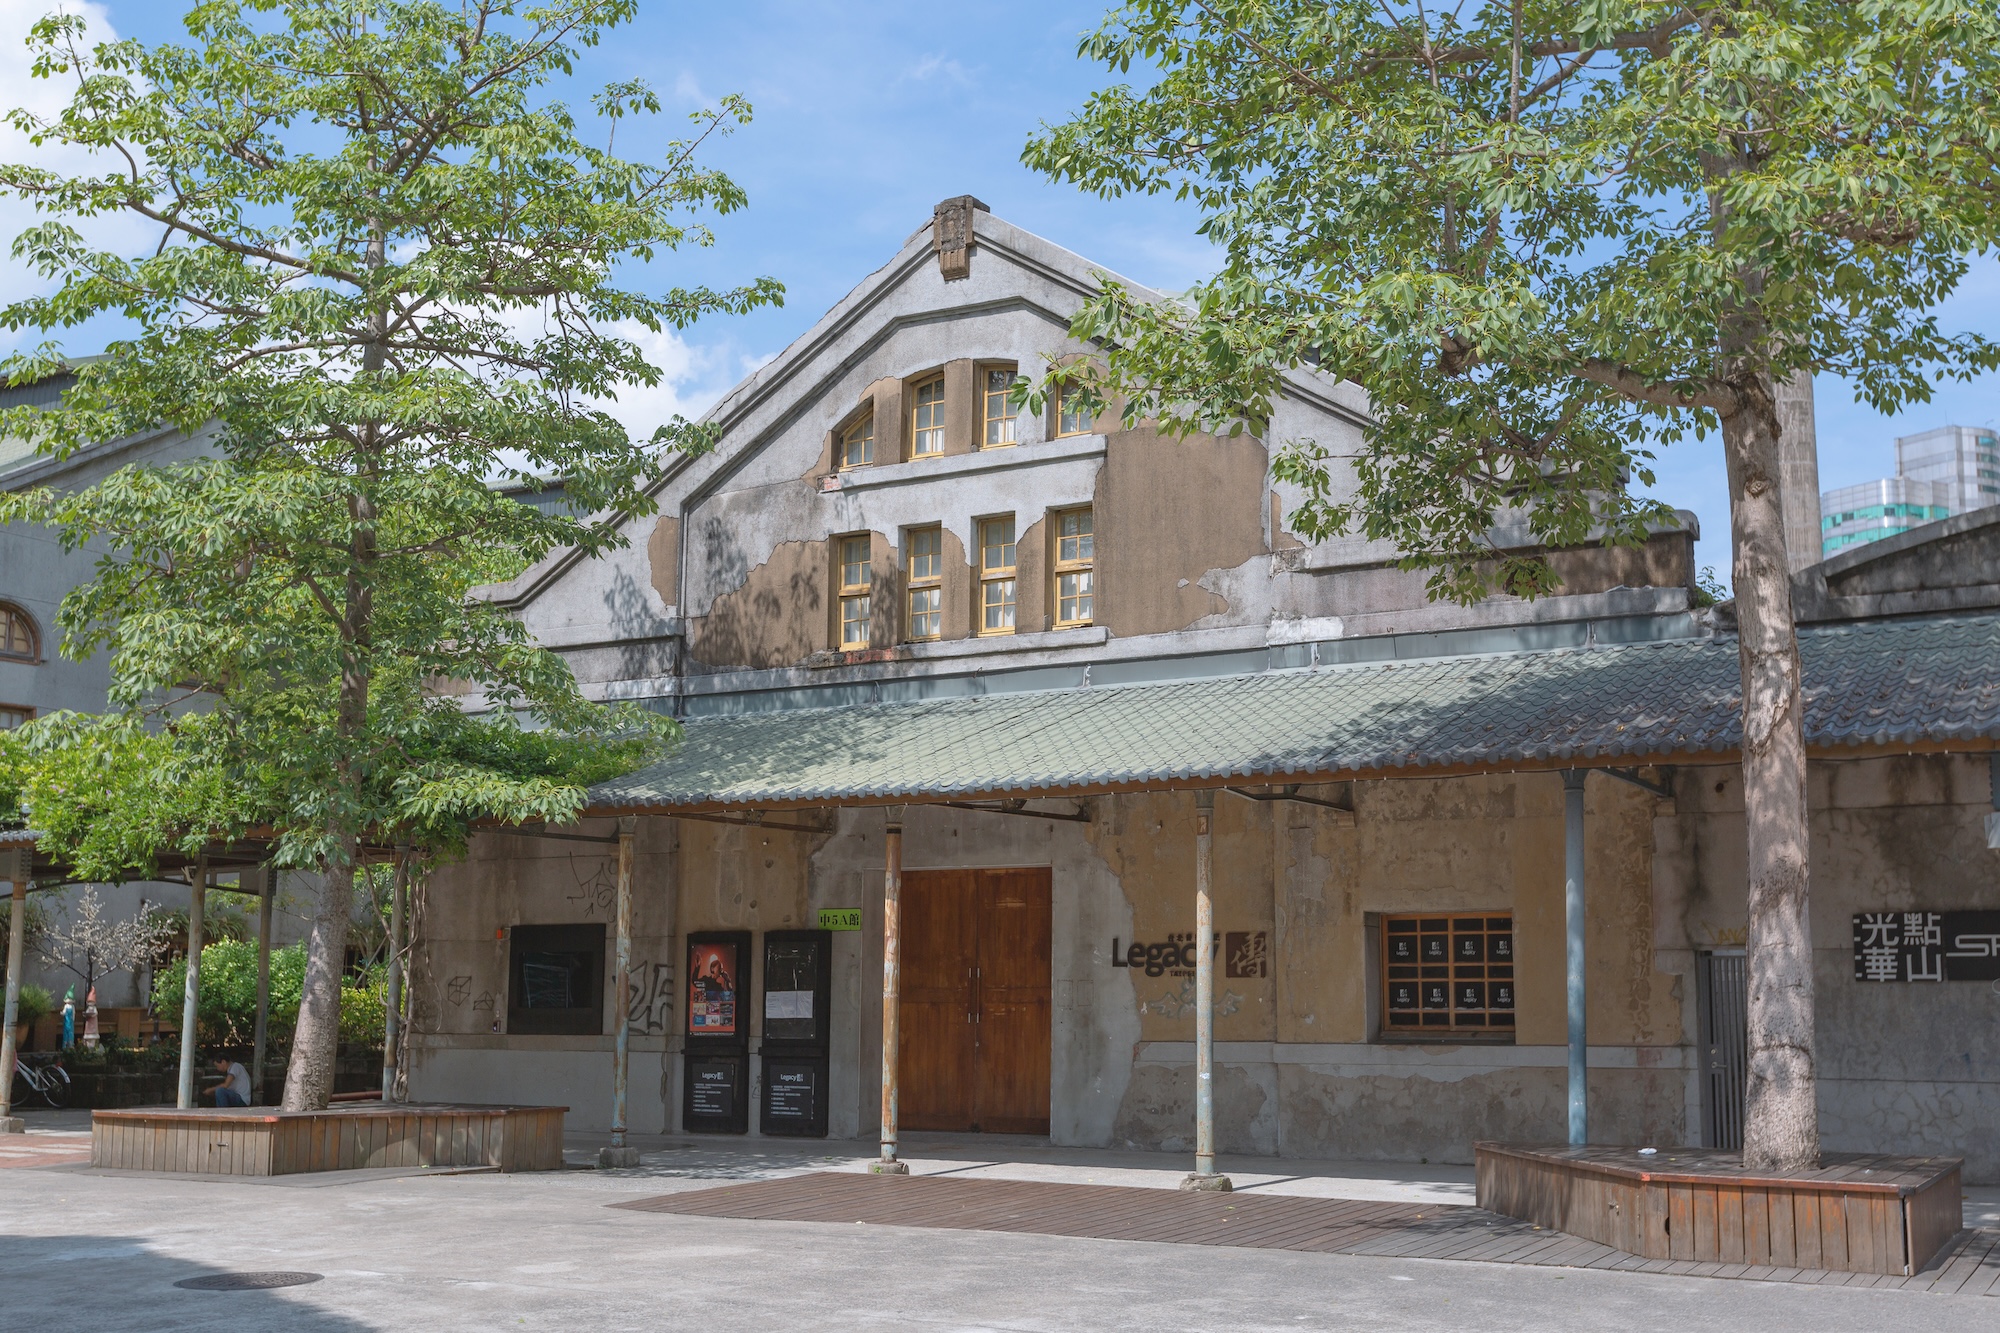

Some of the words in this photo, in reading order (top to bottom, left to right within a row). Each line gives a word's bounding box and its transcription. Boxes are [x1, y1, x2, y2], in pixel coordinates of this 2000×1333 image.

[820, 913, 860, 927] 中5A館
[1861, 912, 1941, 947] 光點
[1862, 946, 1942, 982] 華山
